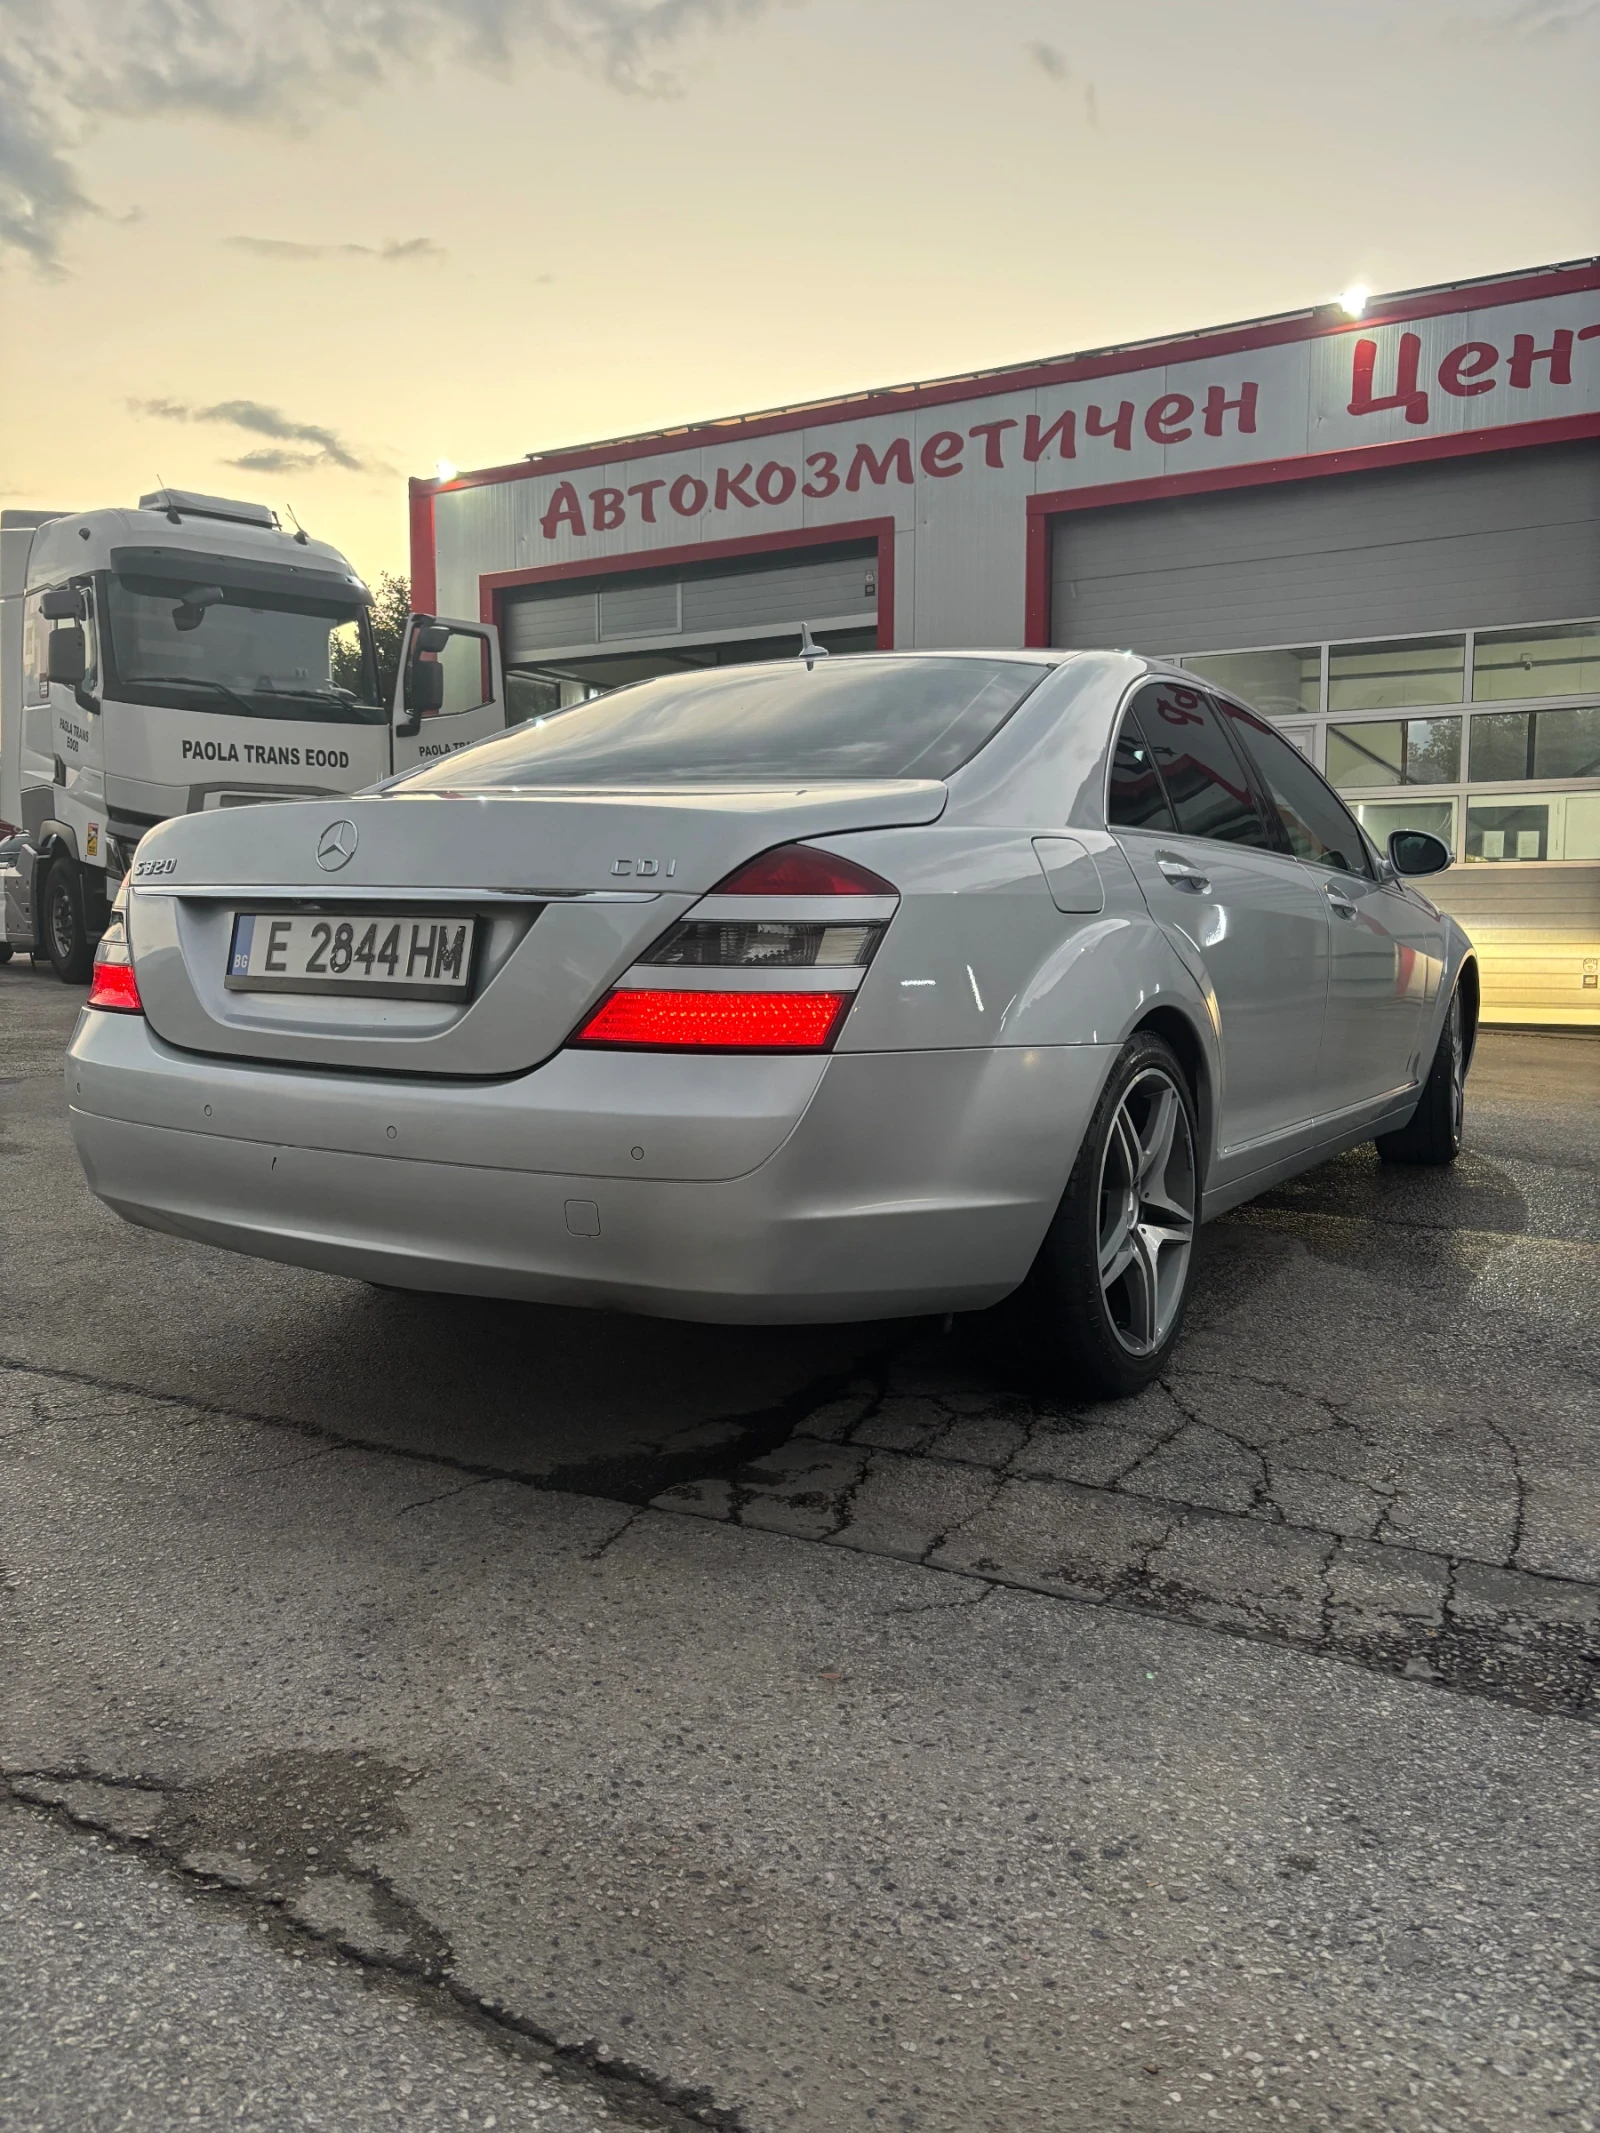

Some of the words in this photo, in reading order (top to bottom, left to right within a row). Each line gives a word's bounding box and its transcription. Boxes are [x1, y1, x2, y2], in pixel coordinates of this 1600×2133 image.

[539, 381, 1259, 540] Автокозметичен
[59, 717, 73, 735] PAOLA
[73, 724, 89, 743] TRANS
[66, 736, 79, 752] EOOD
[182, 739, 239, 762] PAOLA
[243, 744, 300, 765] TRANS
[305, 749, 349, 769] EOOD
[419, 744, 451, 757] PAOLA
[134, 858, 177, 876] S320
[265, 921, 293, 972] E
[233, 954, 248, 968] BG
